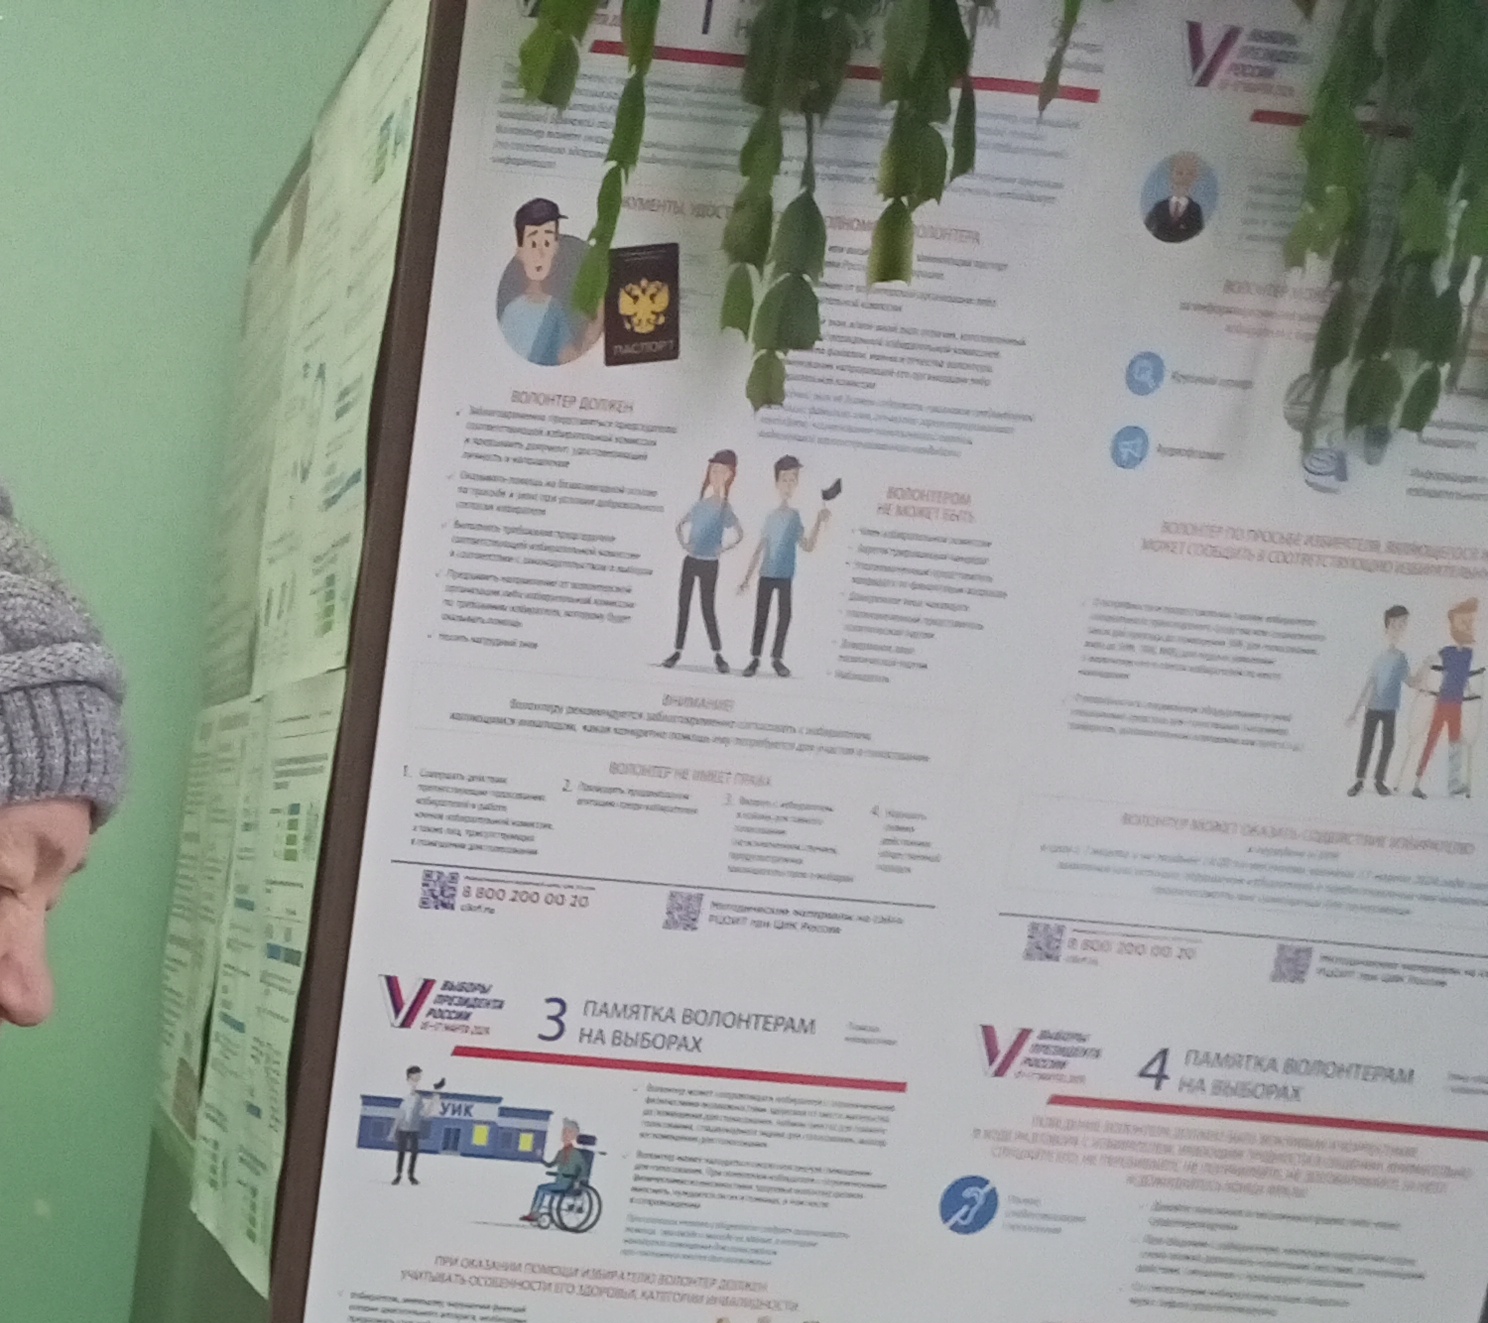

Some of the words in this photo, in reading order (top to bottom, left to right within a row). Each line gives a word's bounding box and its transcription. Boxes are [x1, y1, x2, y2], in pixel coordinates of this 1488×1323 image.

[475, 885, 506, 902] 800
[509, 888, 541, 905] 200
[545, 891, 566, 907] 00
[570, 893, 590, 909] 20
[440, 979, 493, 994] ВЫБОРЫ
[425, 1007, 472, 1023] РОССИИ
[432, 994, 505, 1011] ПРЕЗИДЕНТА
[537, 997, 569, 1042] 3
[583, 998, 677, 1025] ПАМЯТКА
[682, 1005, 817, 1035] ВОЛОНТЕРАМ
[578, 1027, 607, 1046] НА
[611, 1029, 703, 1053] ВЫБОРАХ
[1136, 1047, 1170, 1091] 4
[1184, 1048, 1279, 1074] ПАМЯТКА
[1284, 1054, 1416, 1085] ВОЛОНТЕРАМ
[1177, 1076, 1208, 1094] НА
[1211, 1077, 1304, 1102] ВЫБОРАХ
[439, 1100, 475, 1119] УИК
